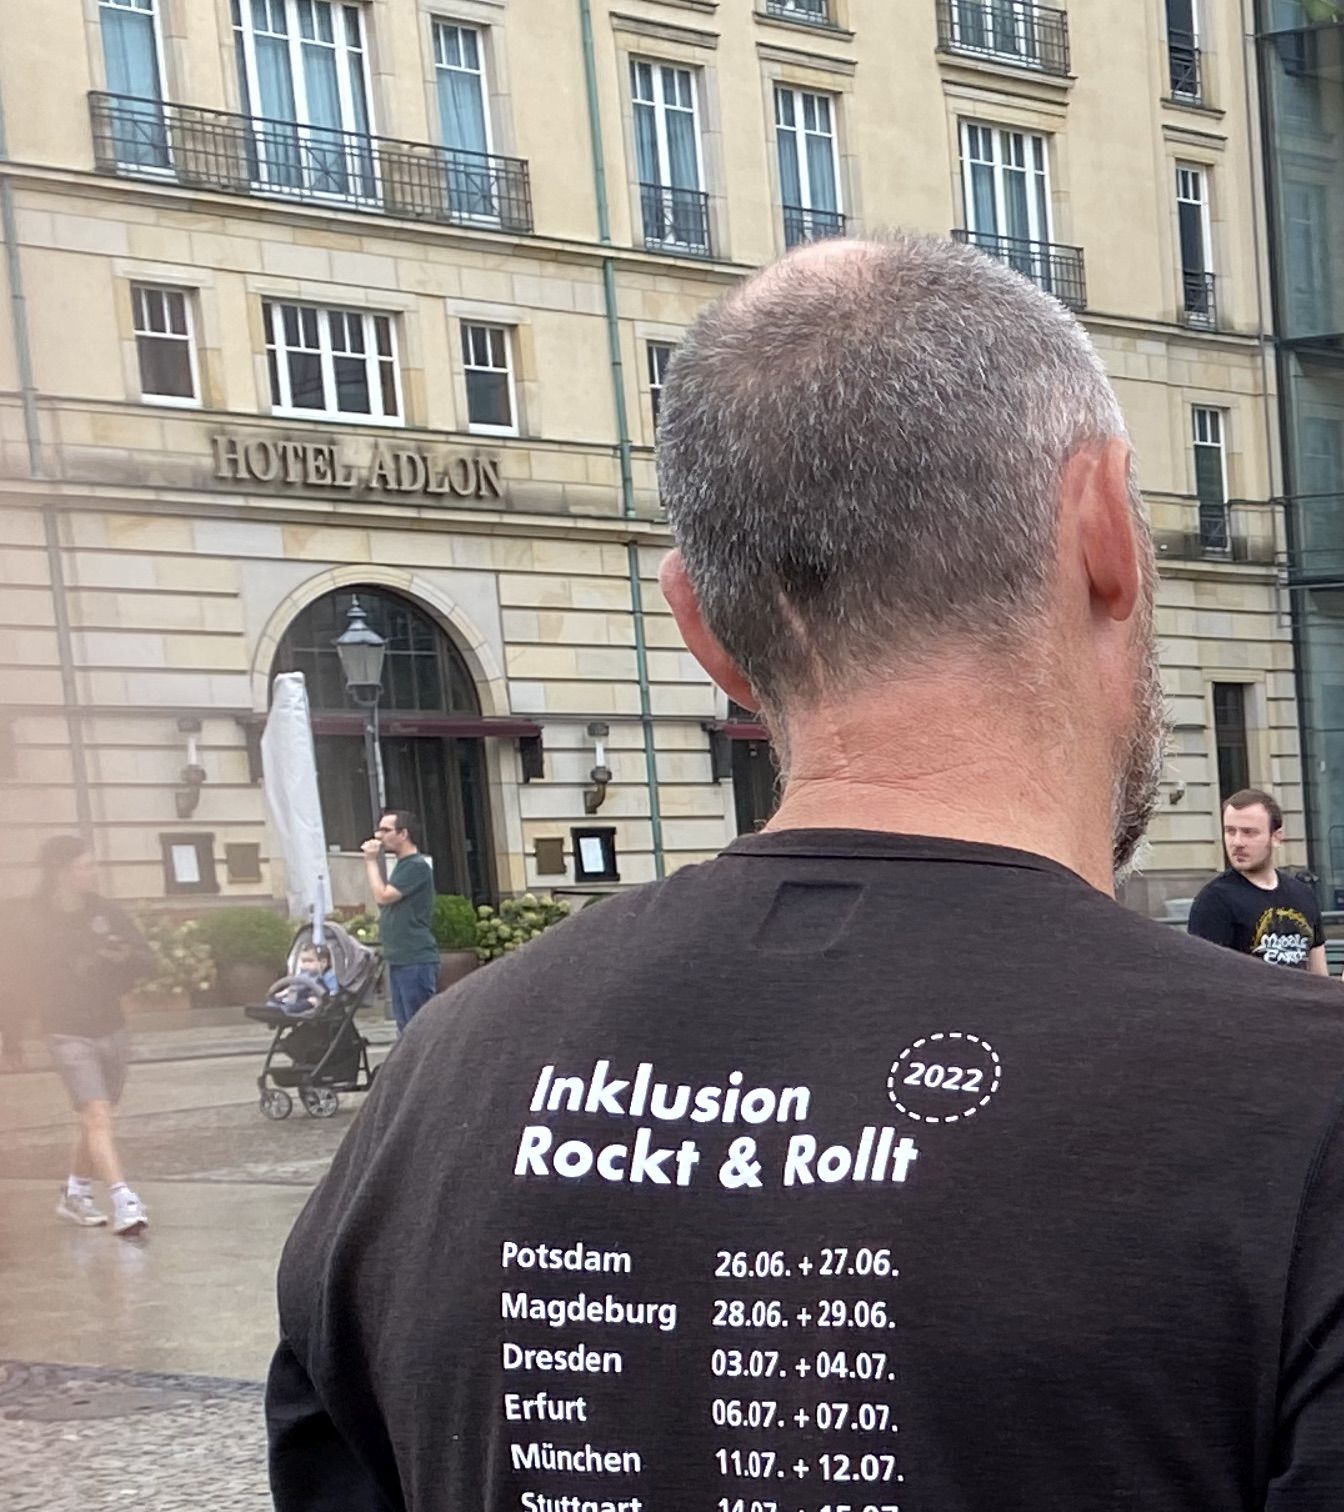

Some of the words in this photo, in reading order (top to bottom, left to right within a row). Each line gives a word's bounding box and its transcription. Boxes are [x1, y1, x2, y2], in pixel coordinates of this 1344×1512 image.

[213, 434, 358, 487] HOTEL
[369, 449, 503, 497] ADLON
[529, 1059, 811, 1125] Inklusion
[903, 1061, 984, 1093] 2022
[514, 1125, 701, 1187] Rockt
[718, 1136, 764, 1190] &
[783, 1126, 919, 1187] Rollt
[501, 1241, 632, 1273] Potsdam
[714, 1250, 791, 1278] 26.06.
[798, 1256, 814, 1276] +
[819, 1247, 900, 1277] 27.06.
[501, 1292, 677, 1332] Magdeburg
[711, 1299, 789, 1328] 28.06.
[796, 1307, 812, 1327] +
[817, 1299, 896, 1329] 29.06.
[503, 1342, 622, 1373] Dresden
[711, 1348, 787, 1378] 03.07.
[794, 1357, 812, 1378] +
[816, 1350, 895, 1381] 04.07.
[504, 1391, 587, 1422] Erfurt
[712, 1398, 785, 1428] 06.07.
[793, 1407, 810, 1429] +
[816, 1402, 898, 1432] 07.07.
[510, 1442, 641, 1473] München
[715, 1448, 785, 1478] 11.07.
[792, 1458, 810, 1479] +
[818, 1453, 904, 1482] 12.07.
